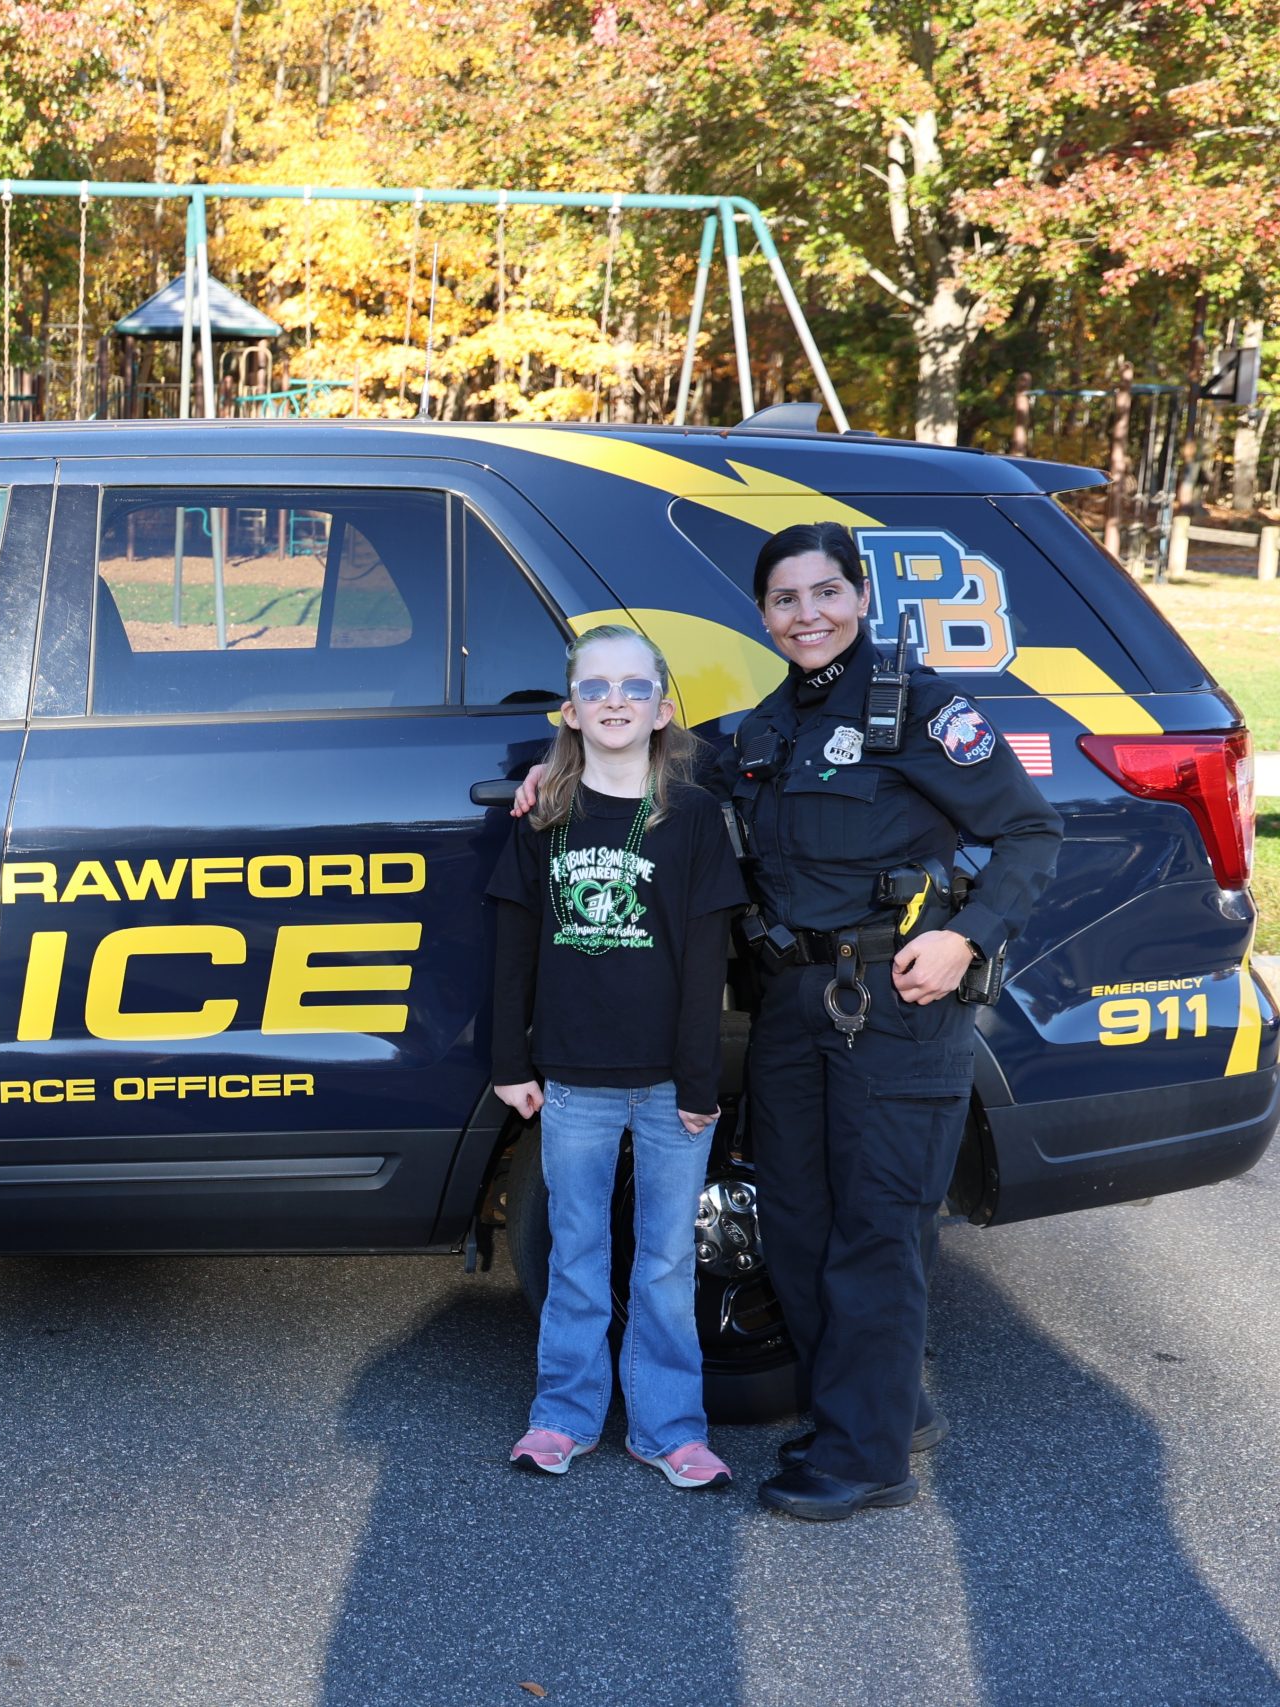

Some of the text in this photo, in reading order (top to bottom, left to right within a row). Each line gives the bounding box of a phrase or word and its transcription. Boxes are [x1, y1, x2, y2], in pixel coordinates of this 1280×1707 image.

[856, 531, 1015, 673] PB
[806, 662, 845, 688] TCPD
[933, 701, 968, 735] CRAWFORD
[833, 748, 850, 759] 116
[965, 732, 993, 760] POLICE
[629, 936, 653, 948] Kind
[1091, 978, 1204, 997] EMERGENCY
[1098, 993, 1208, 1046] 911
[113, 1073, 315, 1101] OFFICER
